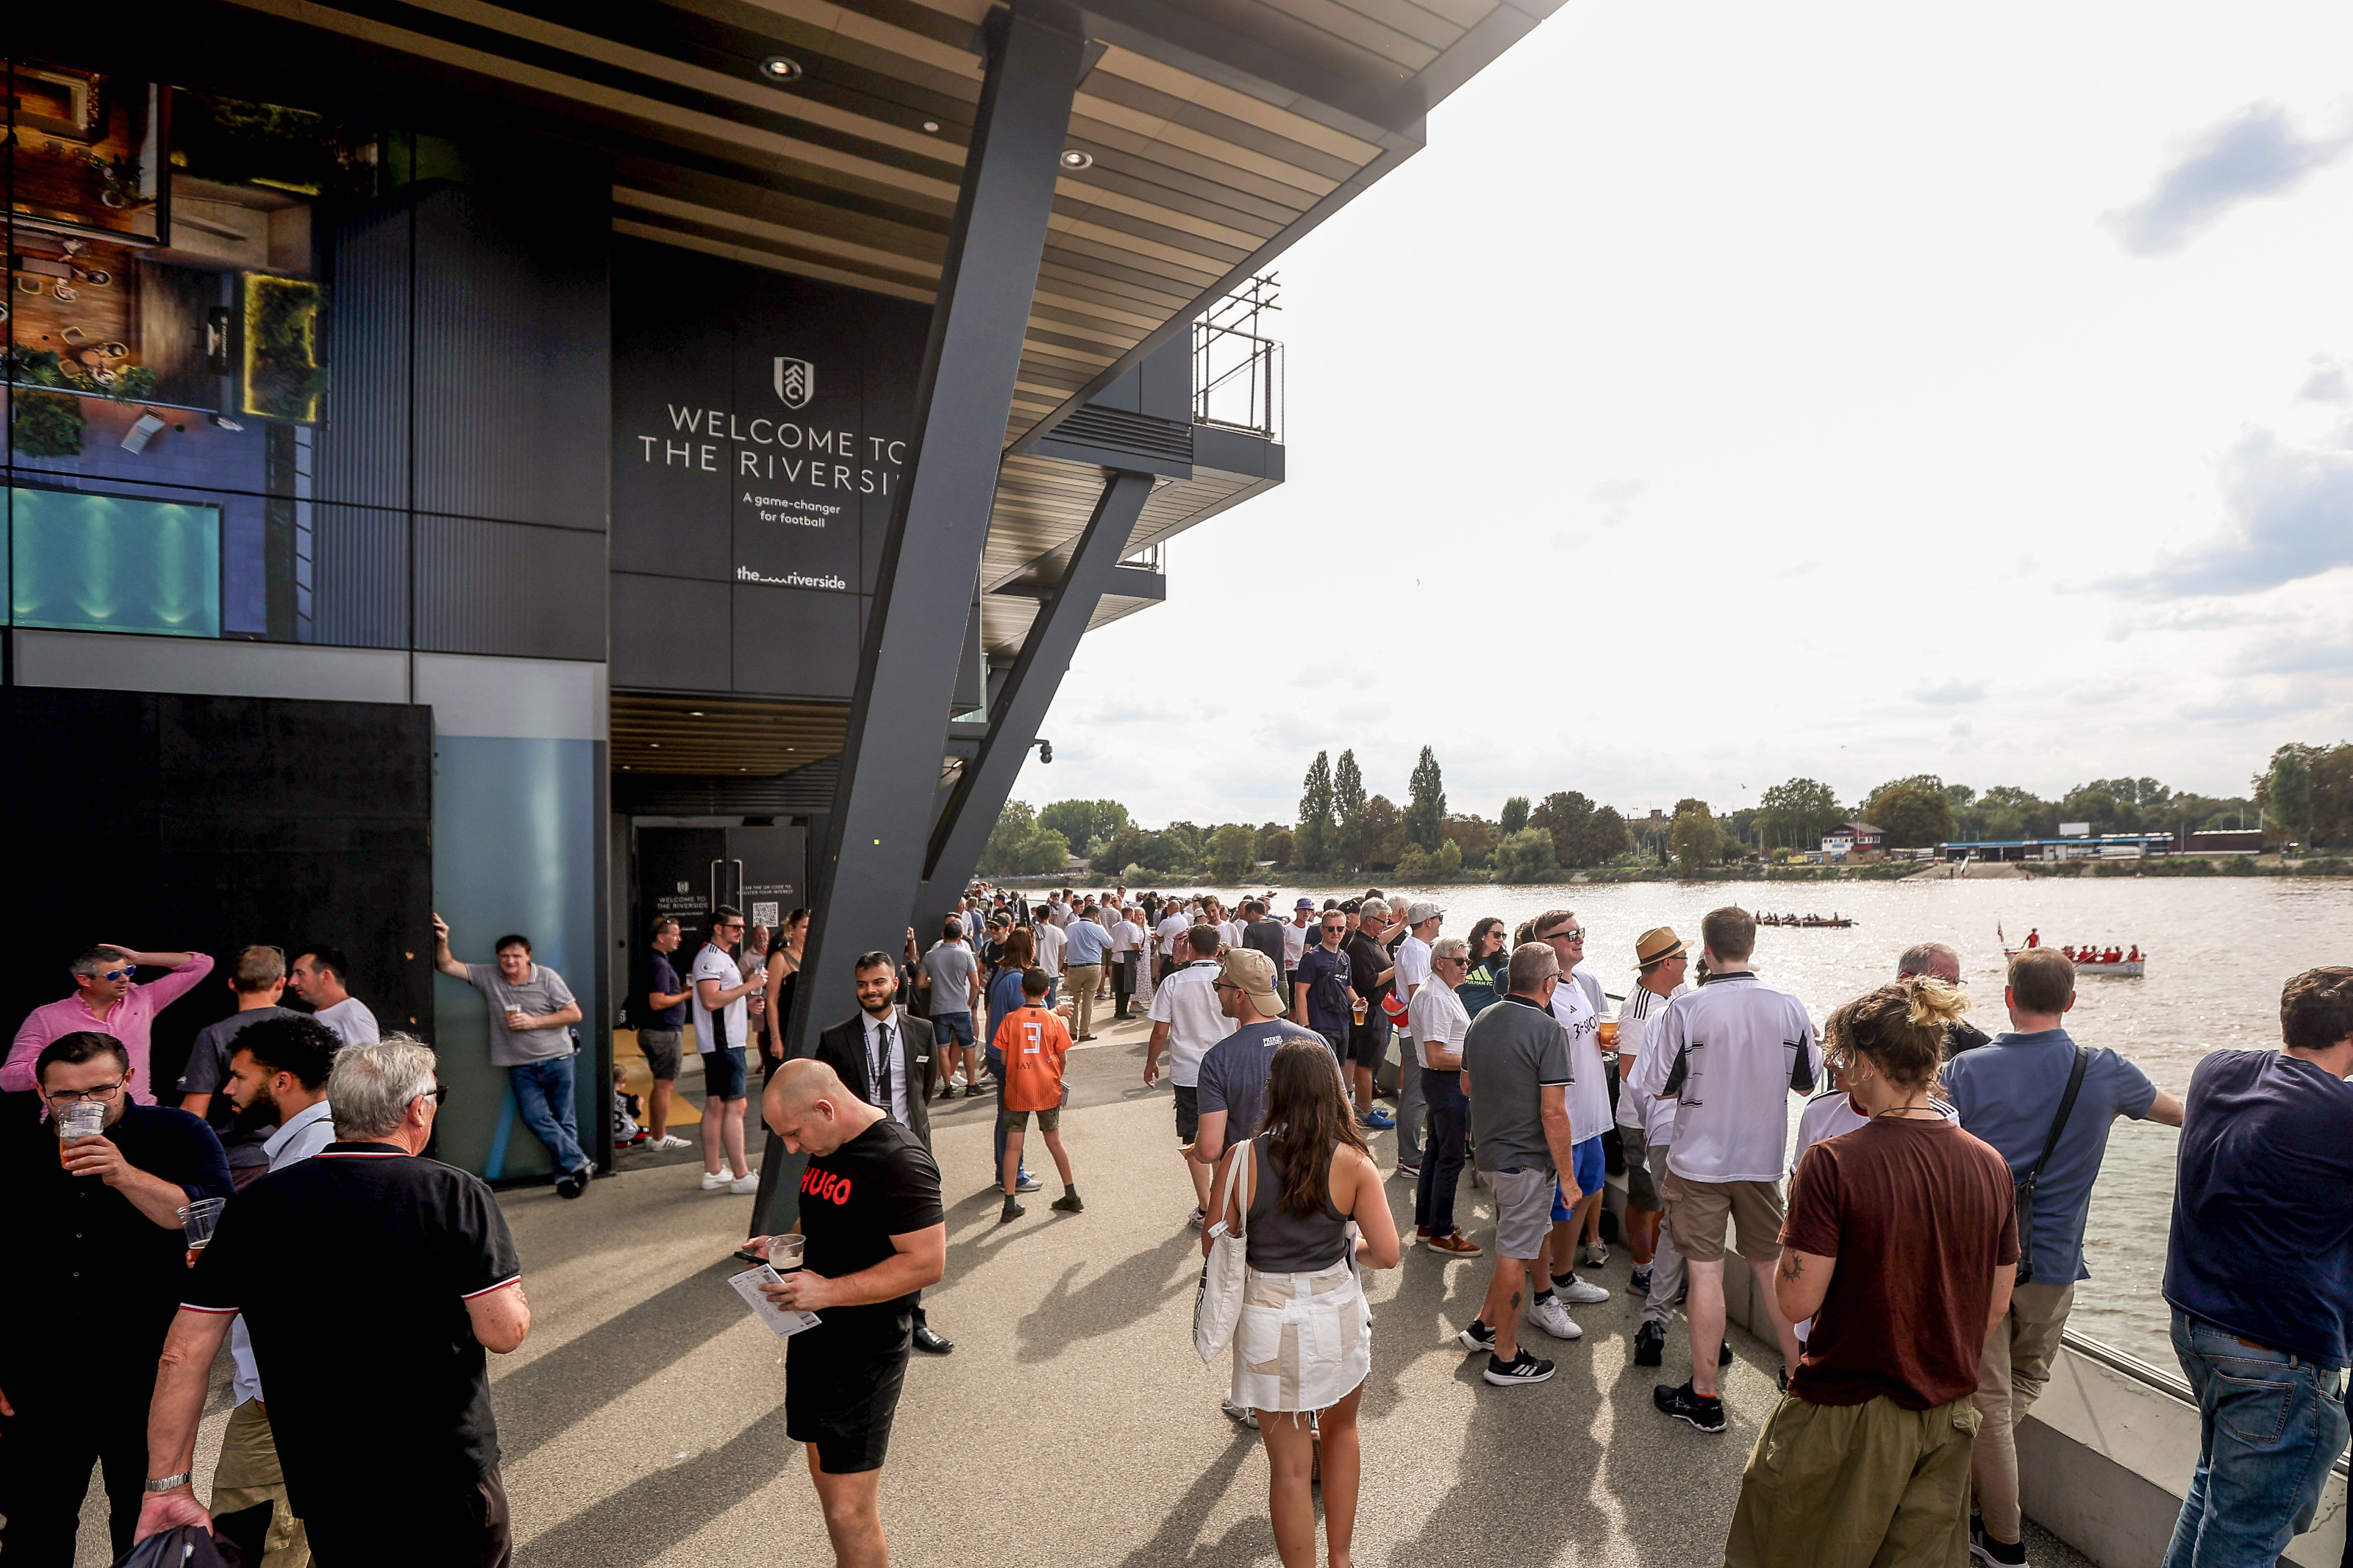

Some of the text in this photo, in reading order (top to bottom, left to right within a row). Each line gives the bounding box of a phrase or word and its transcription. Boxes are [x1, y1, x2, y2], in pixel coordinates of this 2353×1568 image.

[668, 403, 854, 457] WELCOME
[638, 435, 899, 495] THE RIVERSI
[743, 492, 840, 515] A game-changer
[760, 510, 825, 529] for football
[737, 566, 846, 590] the riverside
[1023, 1022, 1042, 1054] 3
[800, 1166, 852, 1206] HUGO
